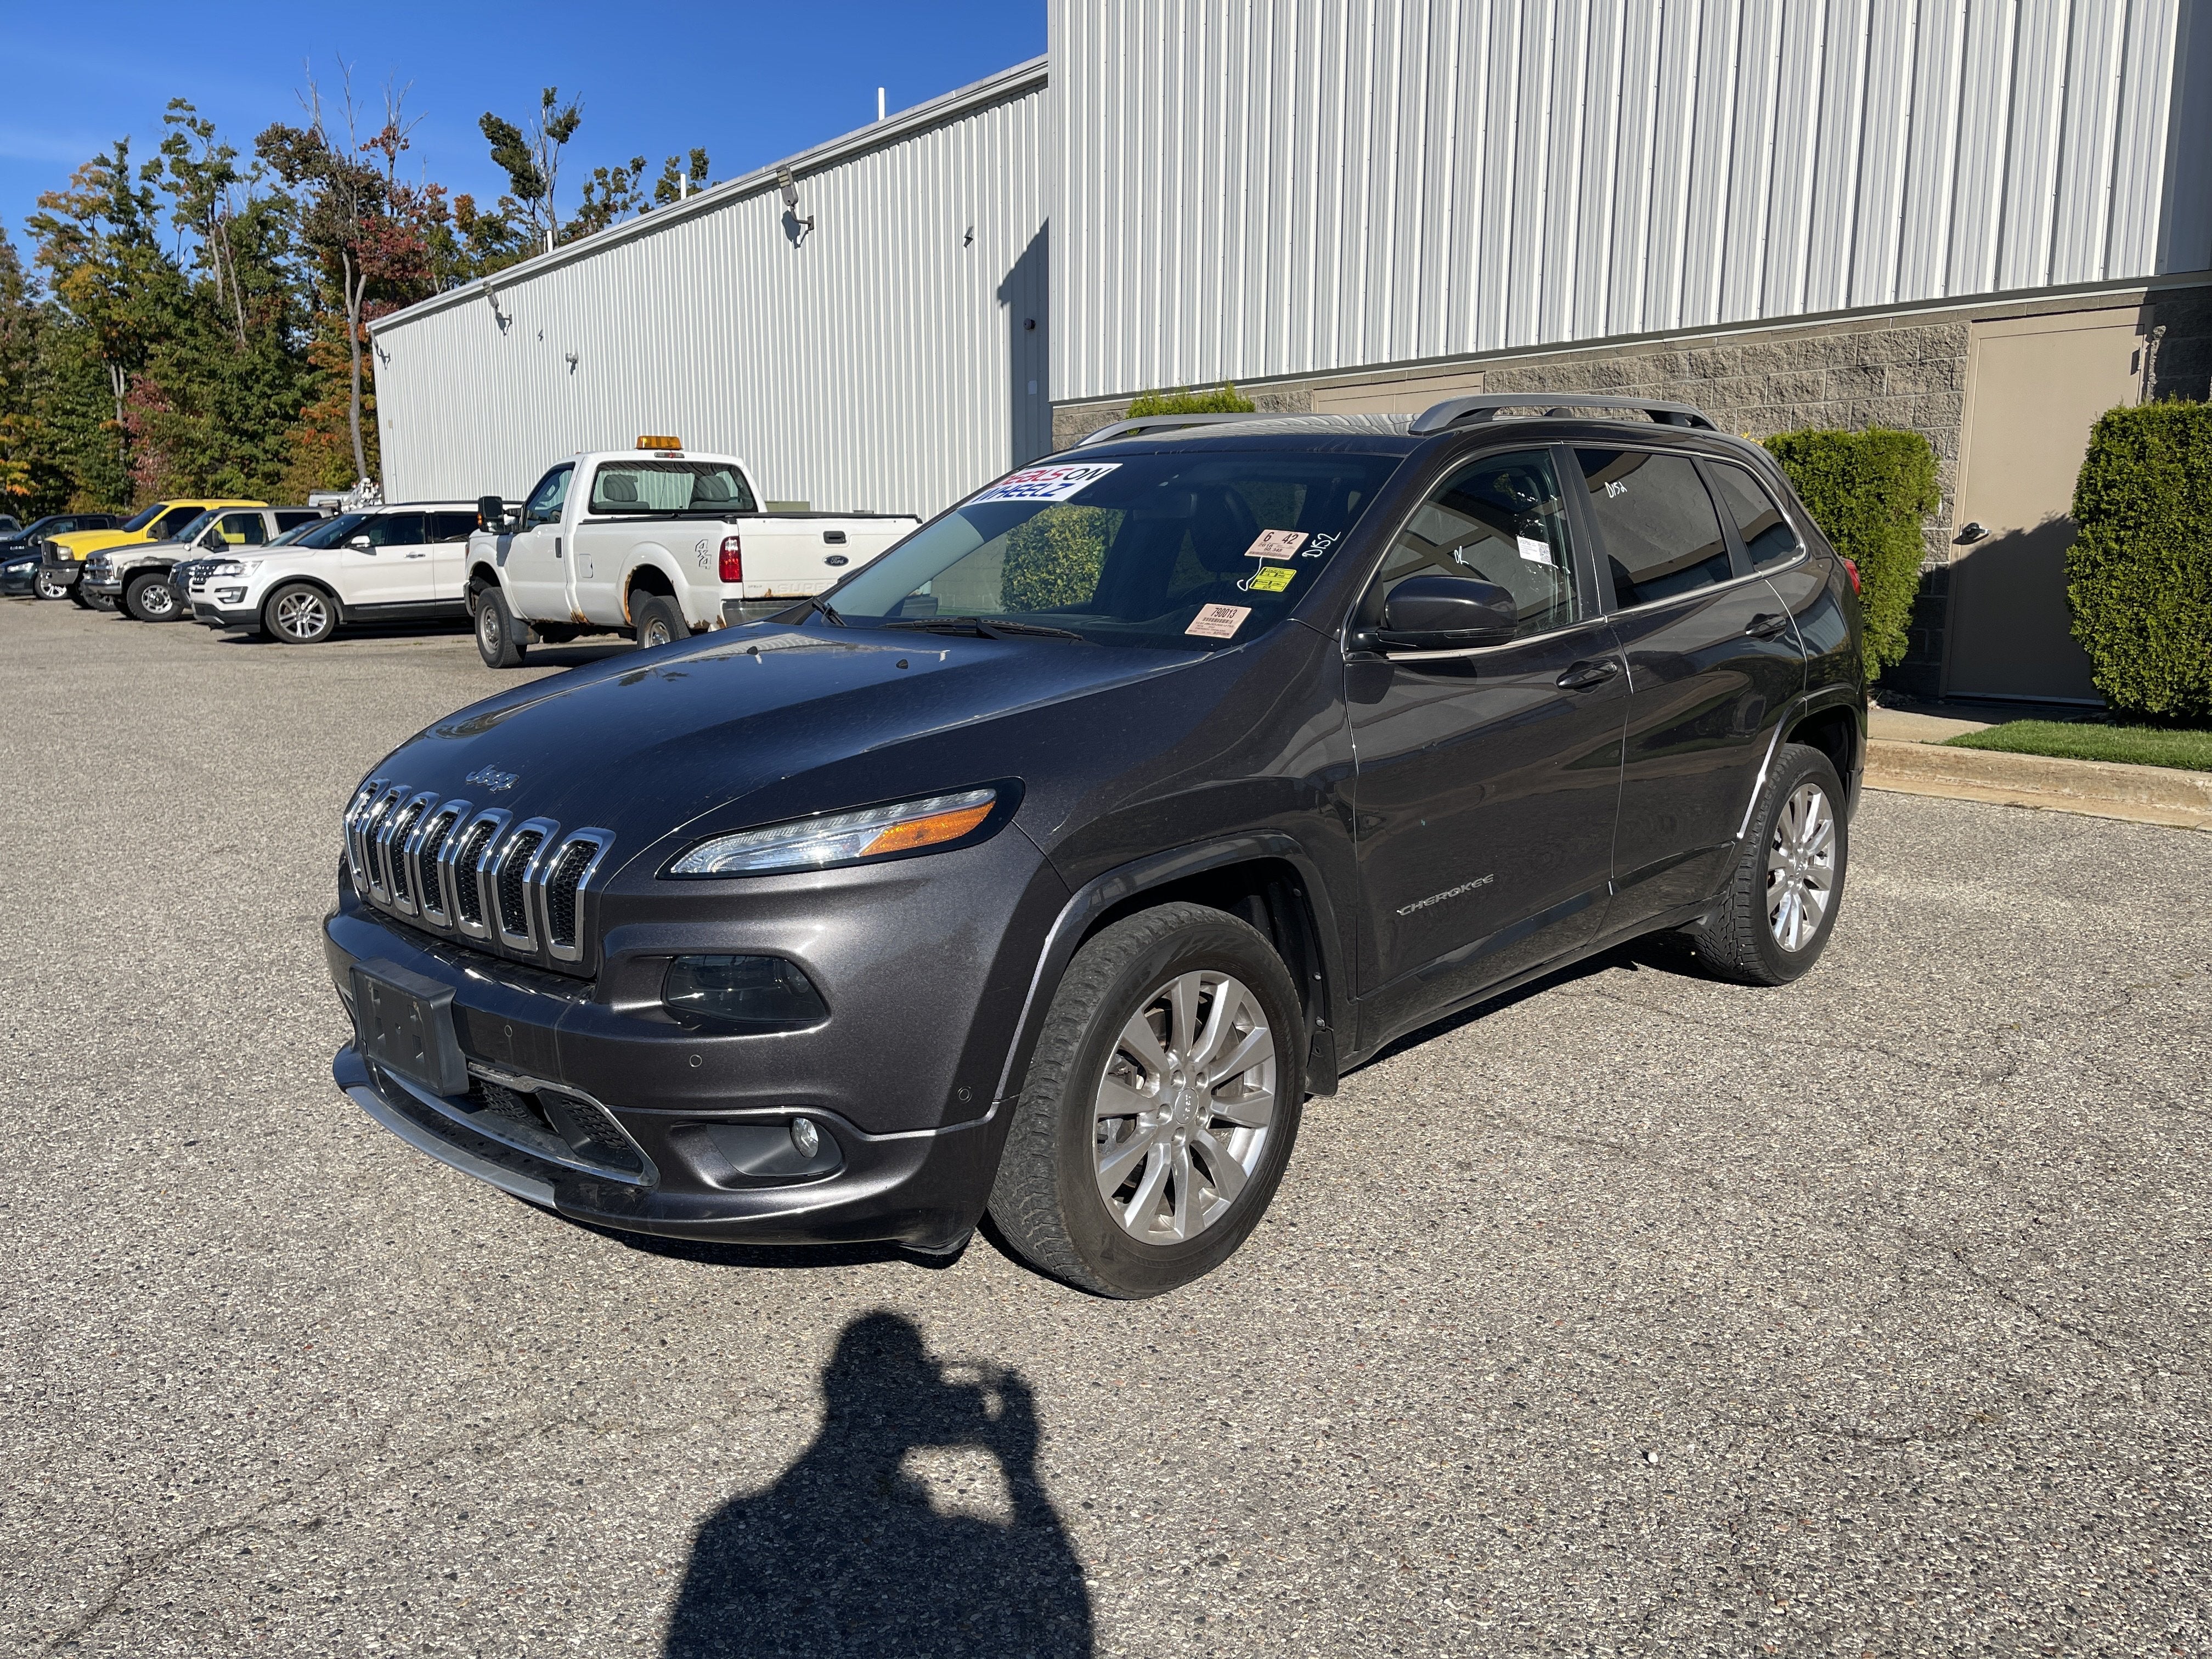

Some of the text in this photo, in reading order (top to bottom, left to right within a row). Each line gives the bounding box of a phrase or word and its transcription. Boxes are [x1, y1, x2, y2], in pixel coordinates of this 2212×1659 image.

[1063, 467, 1113, 481] ON
[972, 483, 1076, 503] WHEELZ
[1263, 532, 1299, 544] 6 42
[1210, 607, 1238, 618] 790013
[465, 764, 520, 792] Jeep
[1396, 873, 1494, 916] CHEROKEE
